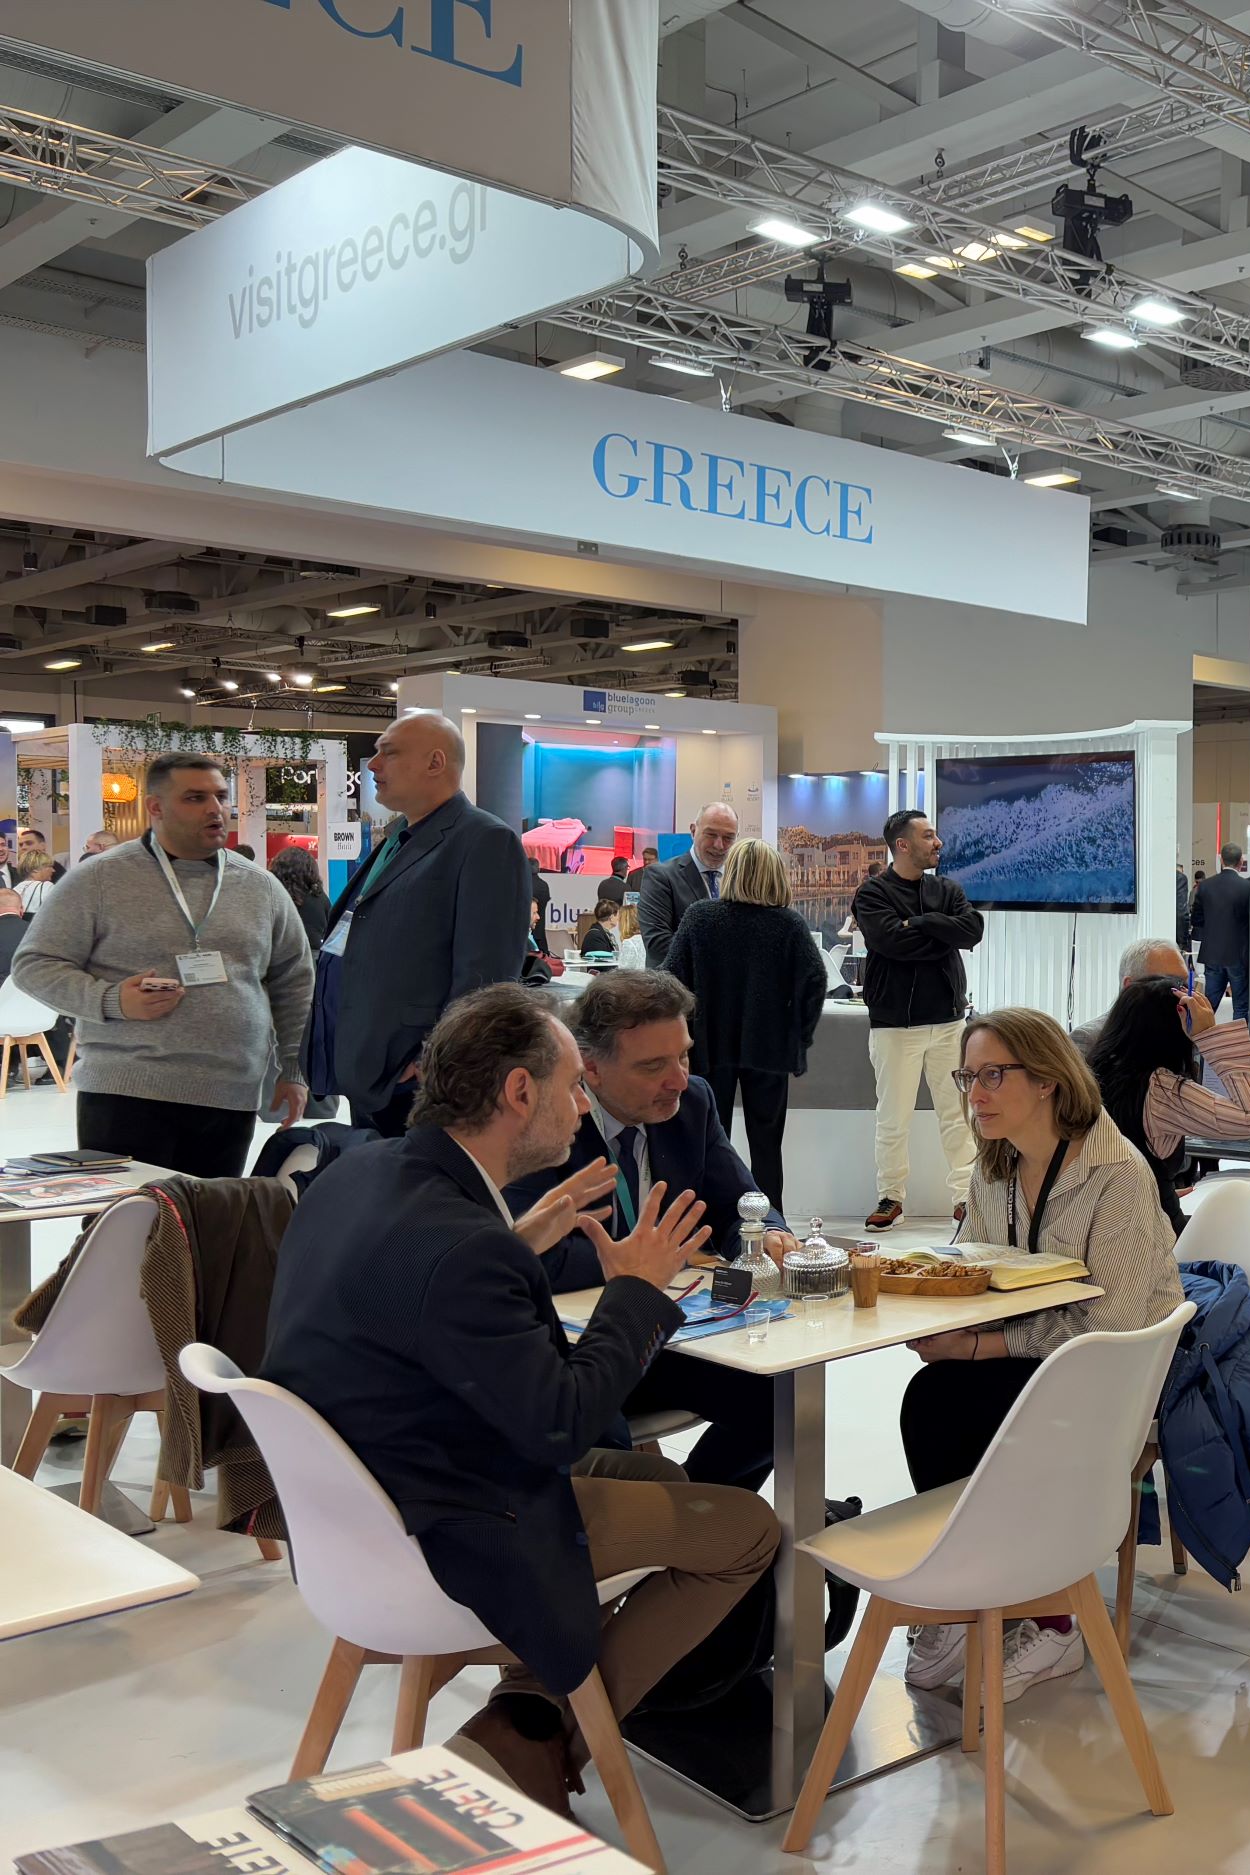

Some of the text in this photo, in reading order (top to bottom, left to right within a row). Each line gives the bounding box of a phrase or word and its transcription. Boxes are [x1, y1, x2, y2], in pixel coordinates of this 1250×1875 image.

[593, 433, 873, 544] GREECE
[608, 704, 634, 716] group
[334, 832, 354, 841] BROWN
[413, 1768, 524, 1830] CRETE
